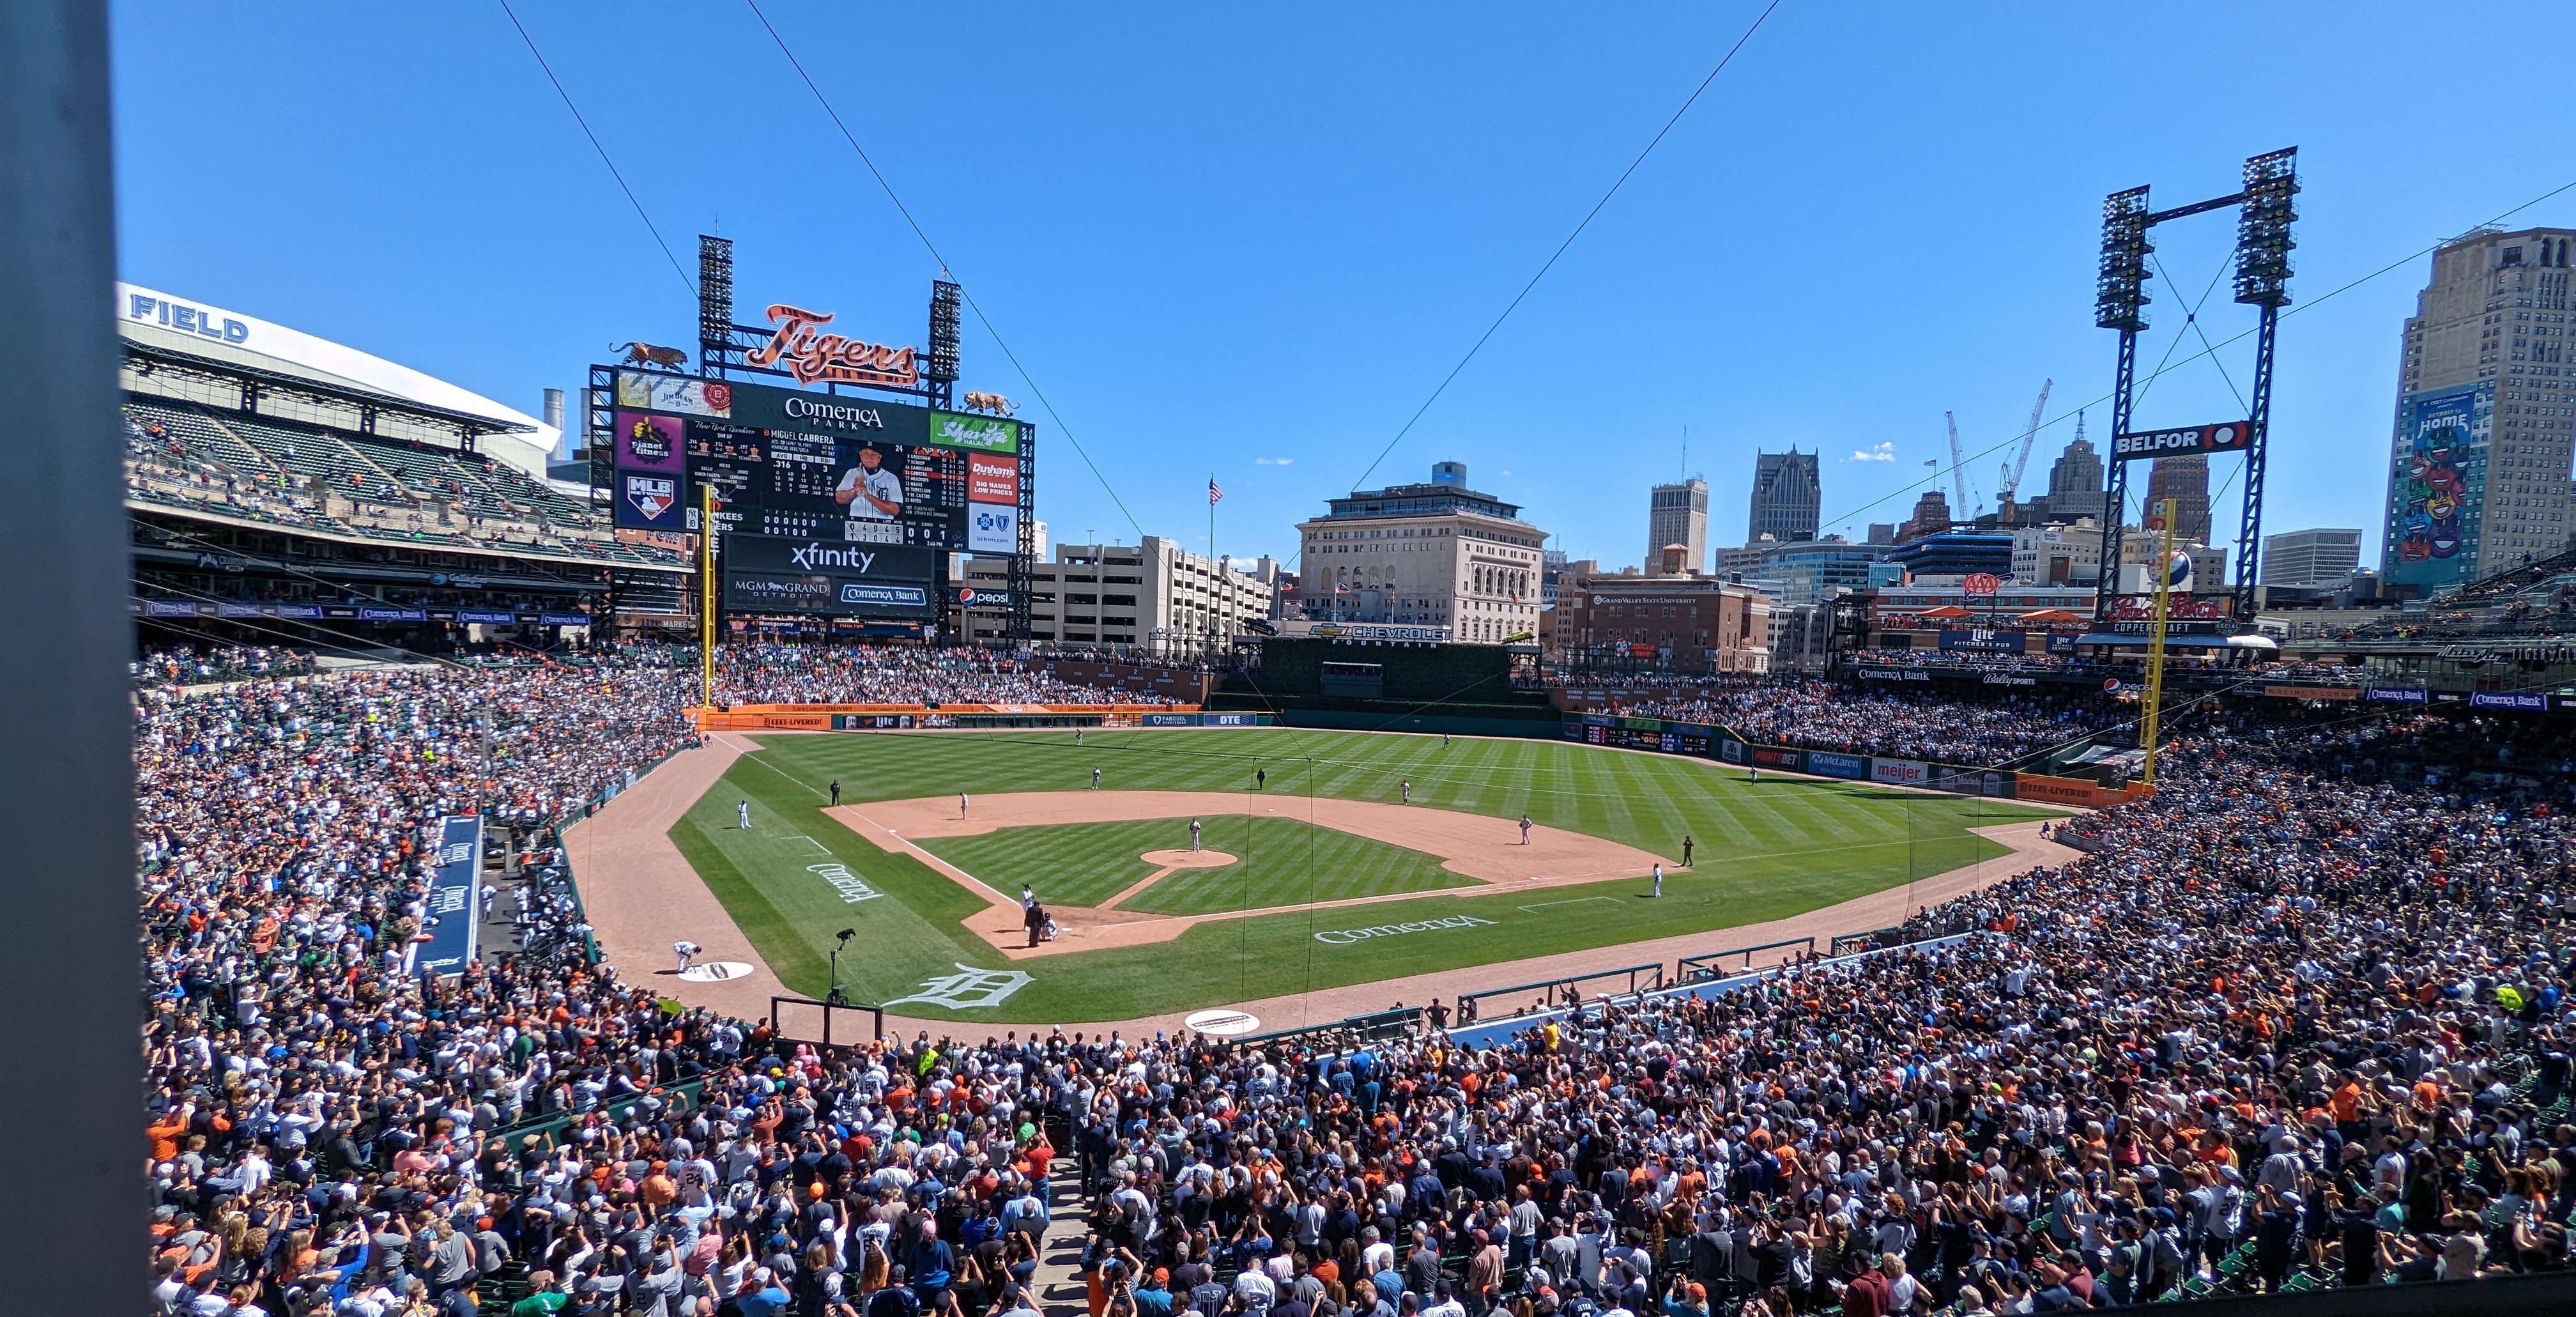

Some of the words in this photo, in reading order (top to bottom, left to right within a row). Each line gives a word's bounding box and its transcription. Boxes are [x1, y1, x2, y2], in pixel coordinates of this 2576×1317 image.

[130, 293, 249, 344] FIELD
[745, 304, 920, 389] Tigers
[661, 392, 674, 403] JIM
[675, 392, 693, 405] BEAM
[694, 420, 710, 429] New
[711, 422, 728, 431] York
[727, 425, 755, 435] Yankees
[813, 418, 858, 431] PARK
[2417, 413, 2469, 440] HOME
[771, 429, 797, 441] MIGUEL
[798, 432, 835, 445] CABRERA
[2116, 431, 2198, 453] BELFOR
[631, 441, 663, 451] planet
[636, 447, 669, 457] fitness
[972, 463, 1015, 476] Dunham's
[630, 479, 671, 493] MLB
[989, 482, 1011, 490] NAMES
[990, 488, 1013, 497] PRICES
[700, 511, 743, 521] YNKEES
[908, 528, 914, 537] 0
[924, 529, 930, 538] 0
[940, 530, 946, 540] 1
[792, 544, 875, 573] xfinity
[735, 580, 767, 592] MGM
[785, 583, 828, 594] GRAND
[1964, 574, 1998, 593] AAA
[895, 590, 919, 601] Bank
[977, 592, 1008, 605] pepsi
[402, 610, 421, 619] Bank
[663, 620, 691, 629] MARKET
[2114, 623, 2190, 633] COPPERCAFT
[1352, 626, 1452, 640] CHEVROLET
[1972, 628, 1995, 642] Lite
[1332, 640, 1437, 648] FOUNTAIN
[1904, 670, 1930, 681] Bank
[1983, 673, 2012, 686] Bally
[2404, 690, 2423, 701] Bank
[2517, 695, 2542, 706] Bank
[876, 716, 894, 727] Lite
[1220, 716, 1241, 725] DTE
[1754, 750, 1797, 766] POINTSBET
[1823, 756, 1859, 767] McLaren
[1878, 763, 1921, 781] meijer
[722, 1036, 733, 1045] 24
[865, 1081, 876, 1089] 24
[1254, 1088, 1265, 1097] 24
[841, 1100, 854, 1110] 28
[928, 1115, 935, 1124] 6
[686, 1173, 702, 1183] 24
